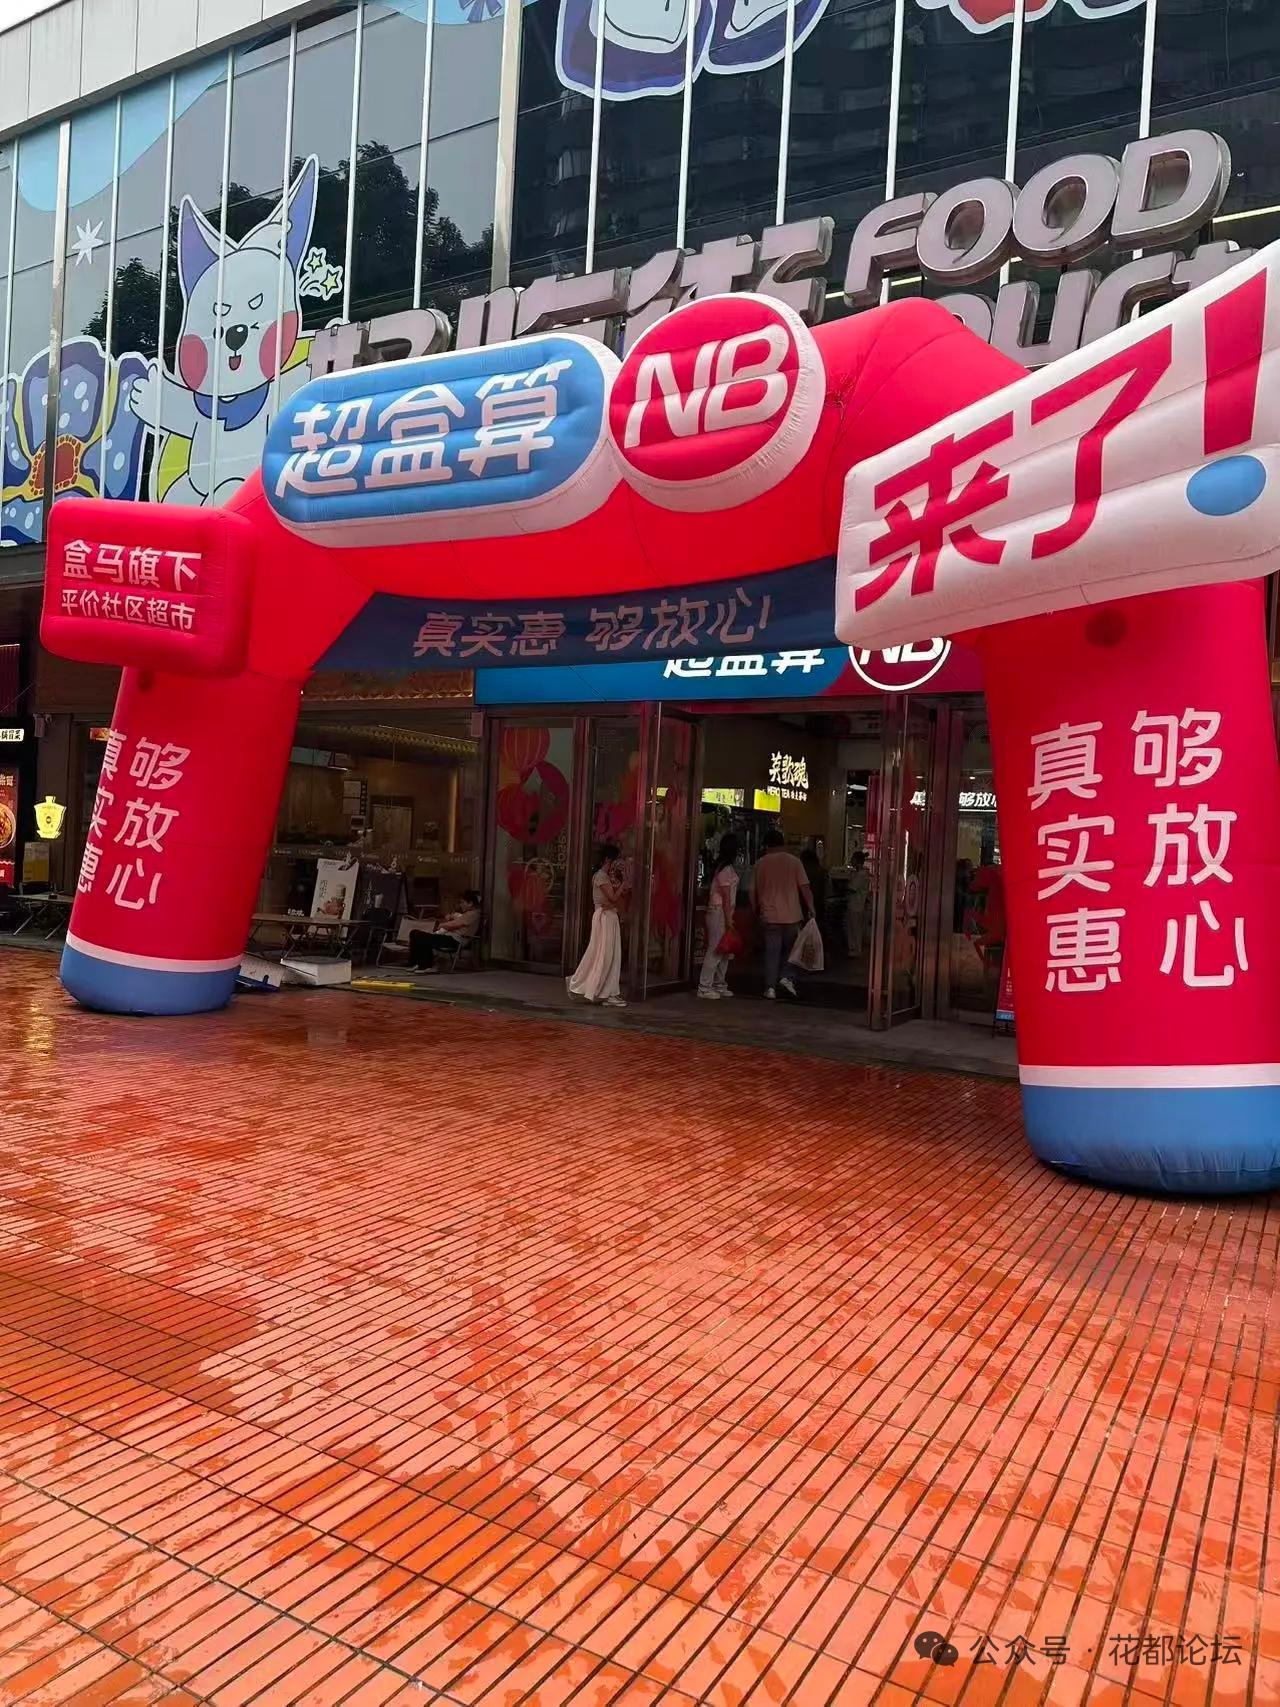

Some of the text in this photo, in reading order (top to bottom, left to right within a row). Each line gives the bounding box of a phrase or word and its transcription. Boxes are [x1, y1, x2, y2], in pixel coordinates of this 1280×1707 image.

[844, 129, 1232, 308] FOOD
[276, 359, 573, 496] 超盒算
[625, 326, 790, 448] NB
[61, 589, 196, 631] 平价社区超市
[63, 540, 201, 592] 盒马旗下
[413, 588, 770, 657] 真实惠 够放心
[105, 737, 191, 910] 够放心
[1027, 722, 1126, 992] 真实惠
[1131, 708, 1249, 988] 够放心
